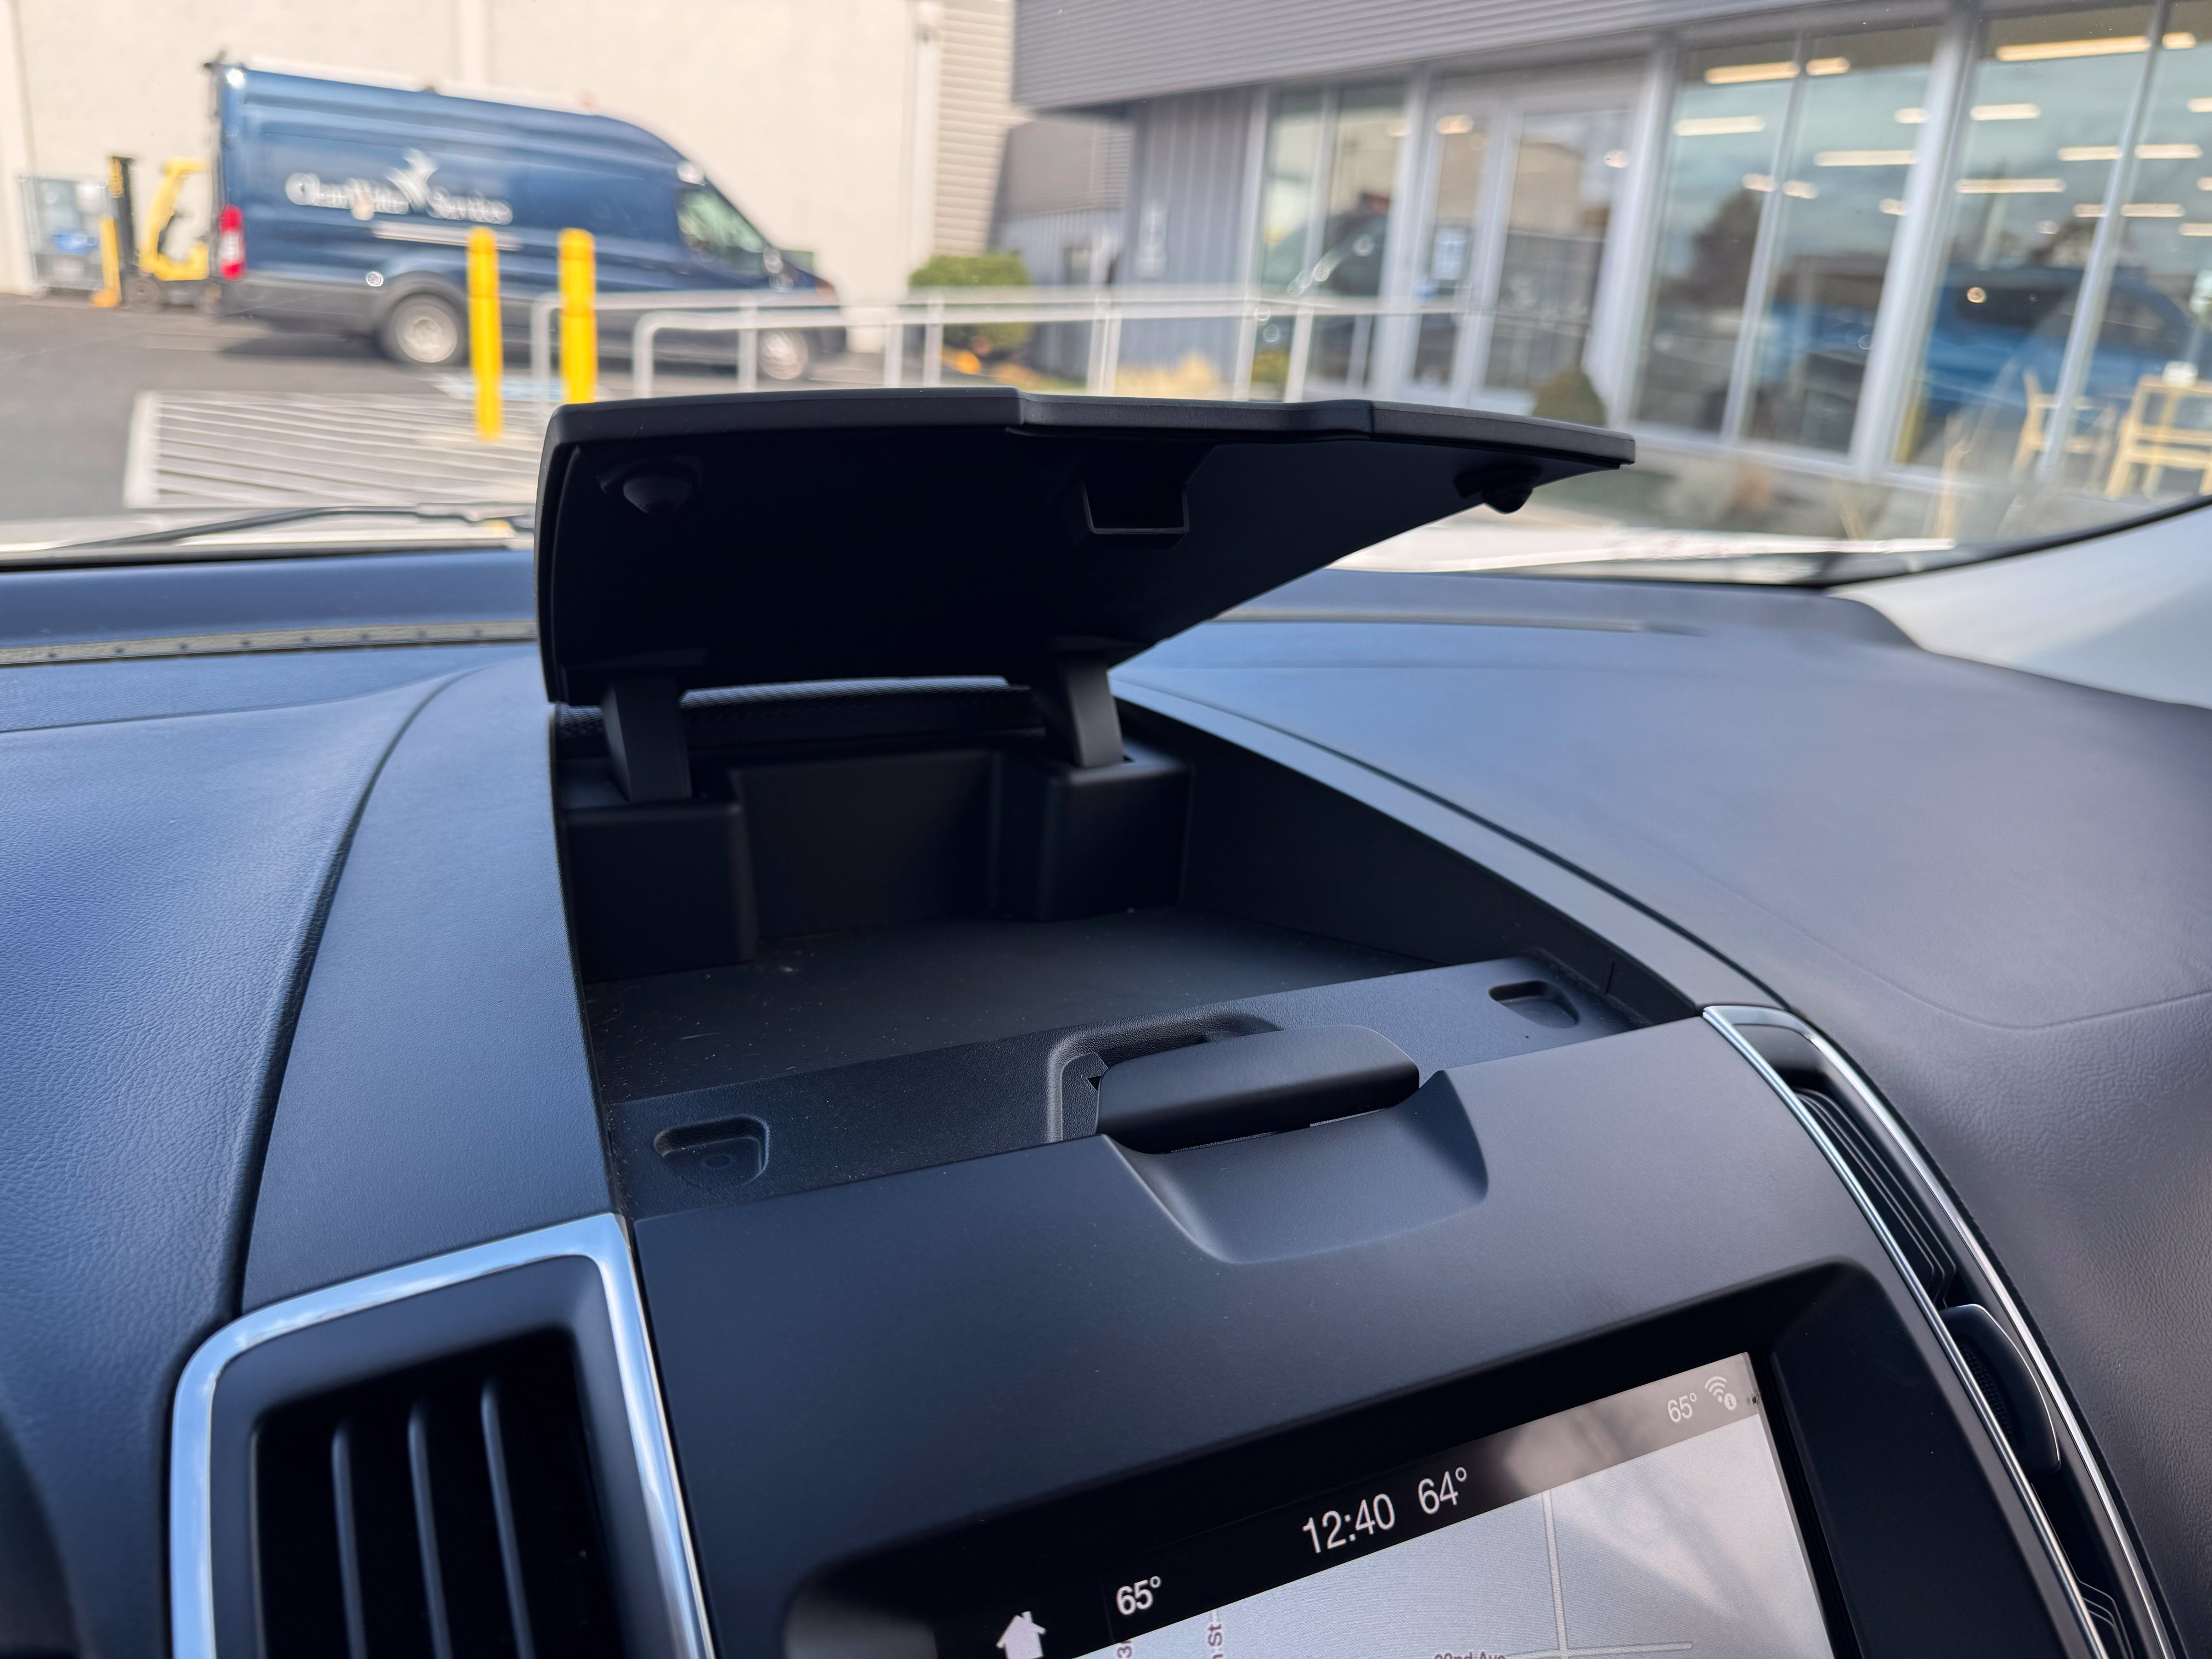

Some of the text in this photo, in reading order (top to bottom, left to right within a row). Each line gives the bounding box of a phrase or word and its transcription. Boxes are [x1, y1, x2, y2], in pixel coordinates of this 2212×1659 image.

[1668, 1392, 1697, 1423] 65°
[1302, 1466, 1468, 1554] 12:40 64°
[1116, 1576, 1161, 1615] 65°
